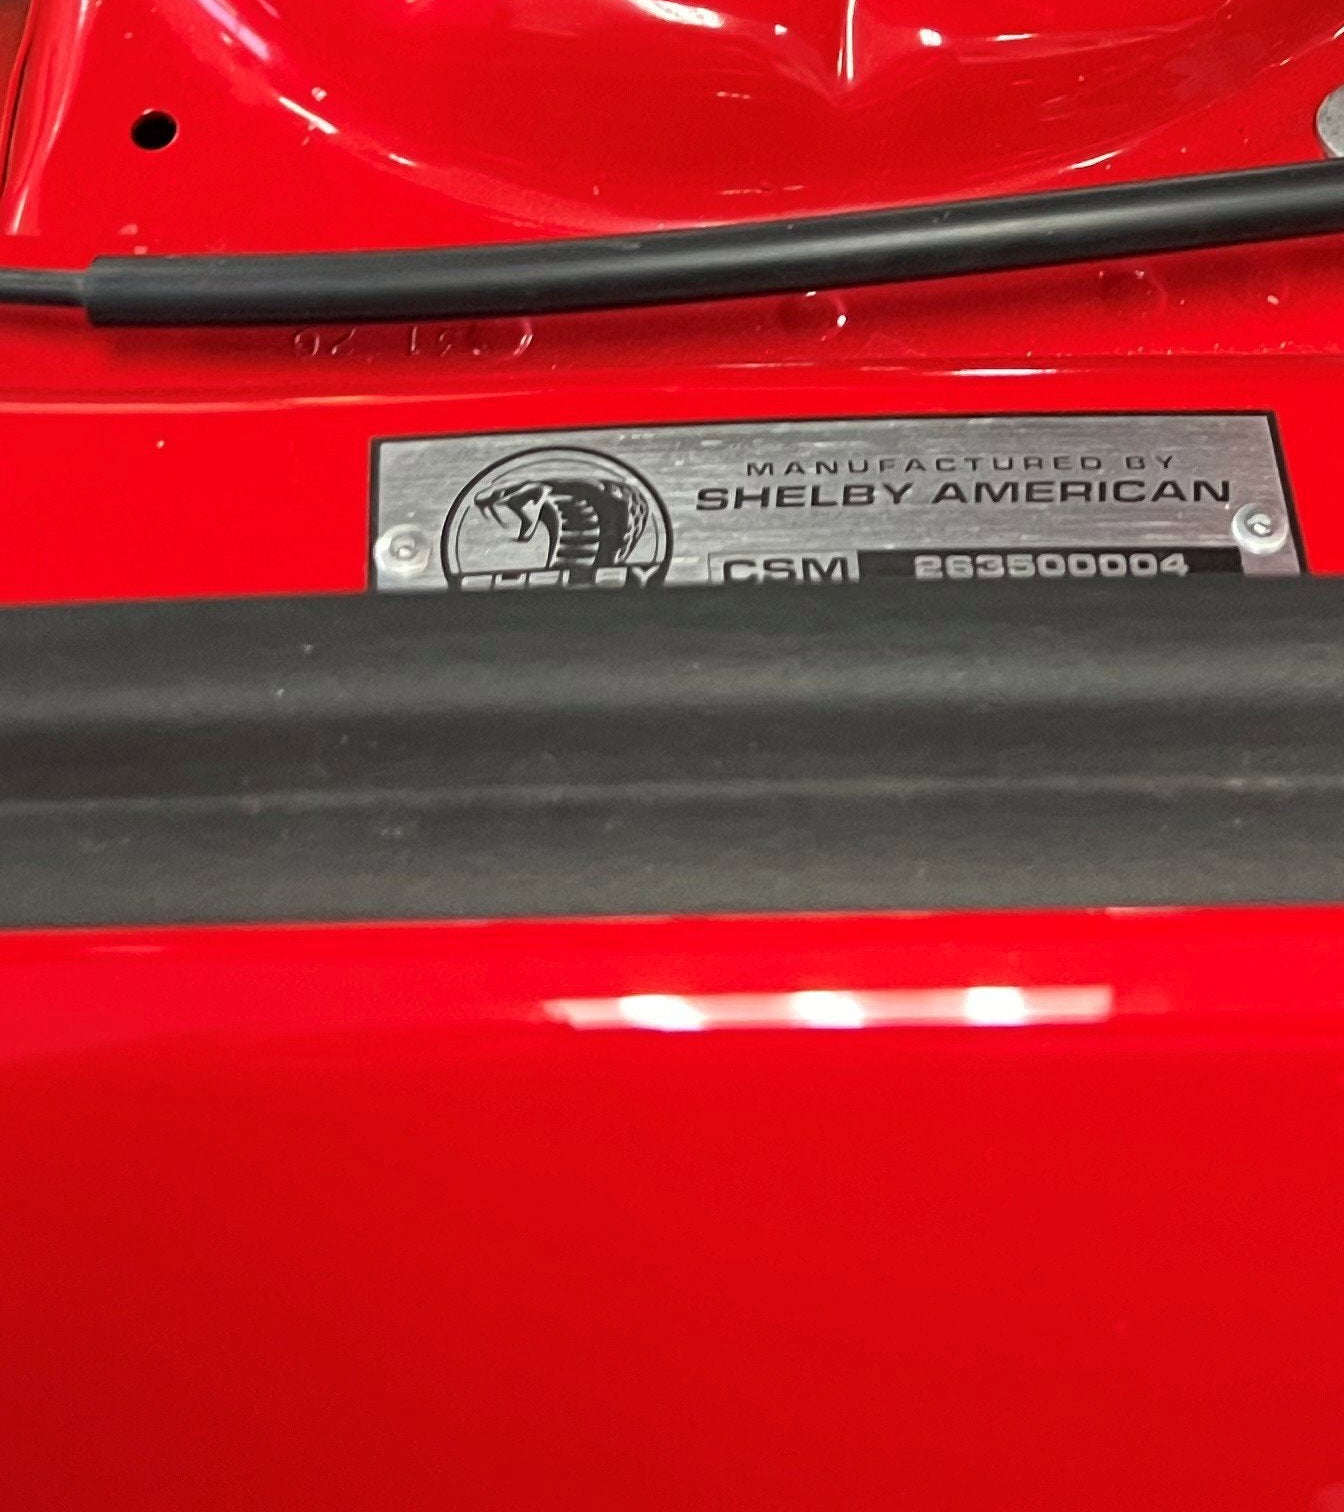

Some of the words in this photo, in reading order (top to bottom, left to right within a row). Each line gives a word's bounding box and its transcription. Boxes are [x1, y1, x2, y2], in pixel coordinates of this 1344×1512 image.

[746, 454, 1104, 477] MANUFACTURED
[1125, 454, 1175, 471] BY
[695, 481, 914, 512] SHELBY
[931, 479, 1232, 504] AMERICAN
[722, 555, 850, 584] CSM
[912, 551, 1190, 580] 263500004
